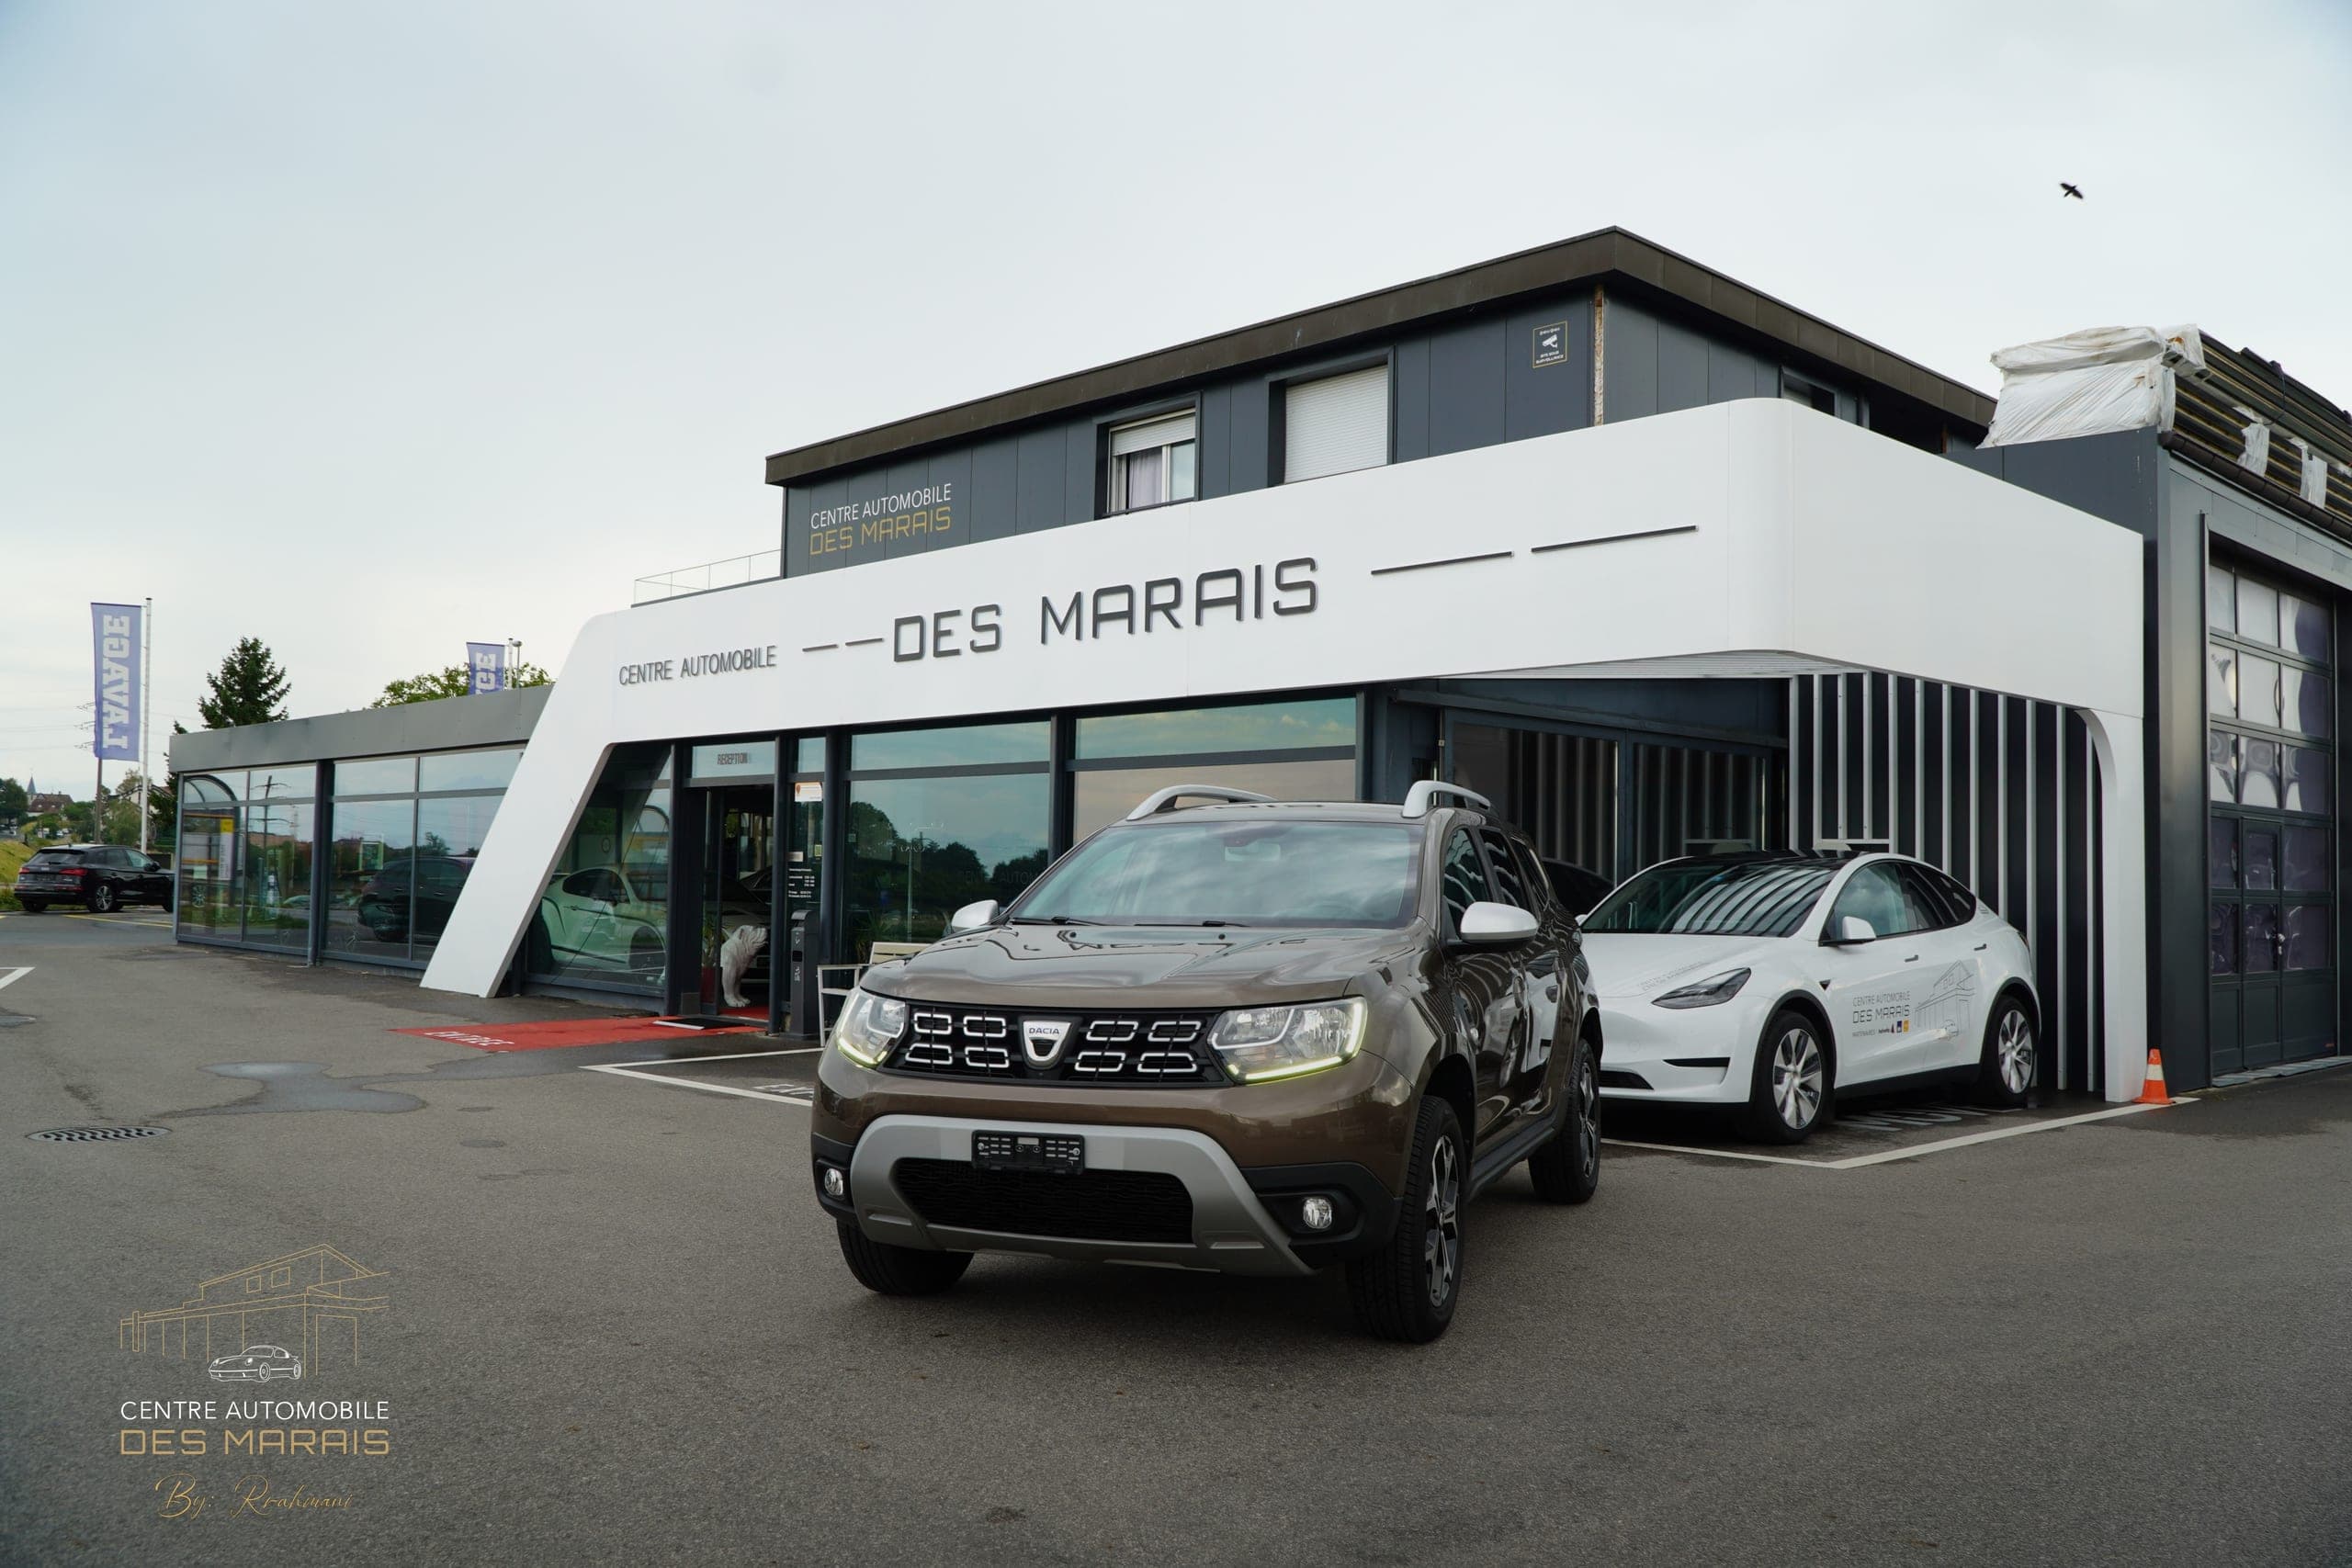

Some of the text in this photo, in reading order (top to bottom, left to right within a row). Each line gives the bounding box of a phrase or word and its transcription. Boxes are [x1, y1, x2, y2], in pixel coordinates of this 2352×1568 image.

[810, 483, 952, 530] CENTRE AUTOMOBILE
[809, 506, 951, 556] DES MARAIS
[619, 557, 1318, 685] CENTRE AUTOMOBILE DES MARAIS
[717, 751, 749, 765] RECEPTION
[1852, 995, 1875, 1007] CENTRE
[1852, 1004, 1910, 1023] DES MARAIS
[1028, 1026, 1060, 1035] DACIA
